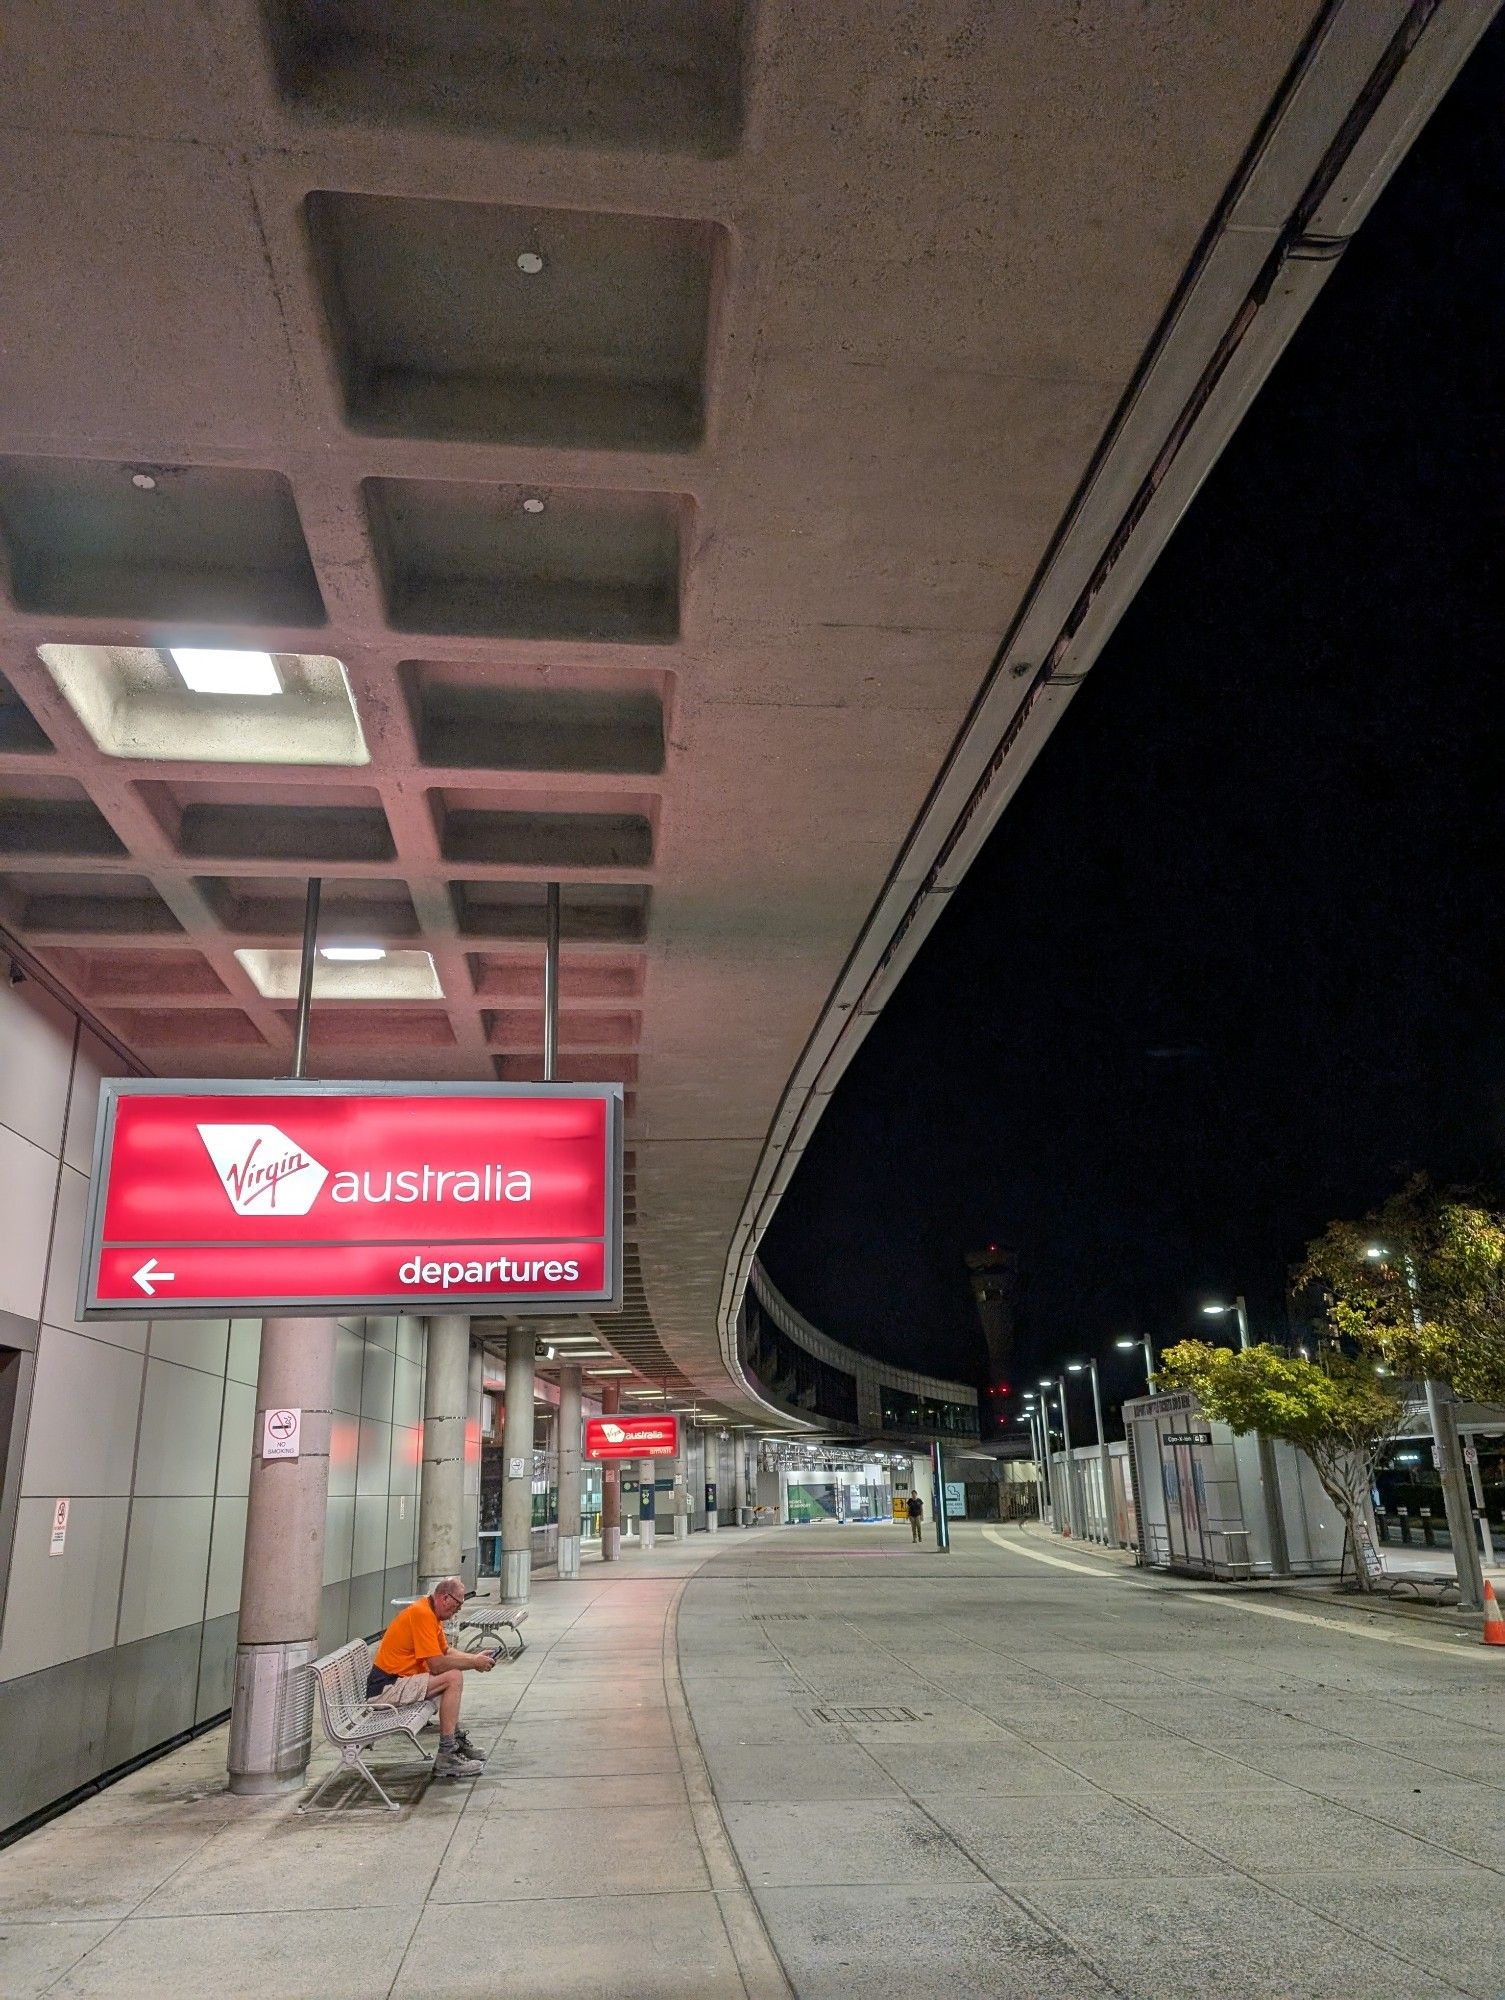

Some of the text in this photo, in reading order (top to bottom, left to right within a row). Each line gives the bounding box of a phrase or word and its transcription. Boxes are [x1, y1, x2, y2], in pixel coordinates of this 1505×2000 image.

[226, 1139, 532, 1208] Virgin australia
[399, 1256, 579, 1288] departures
[625, 1431, 663, 1440] australia
